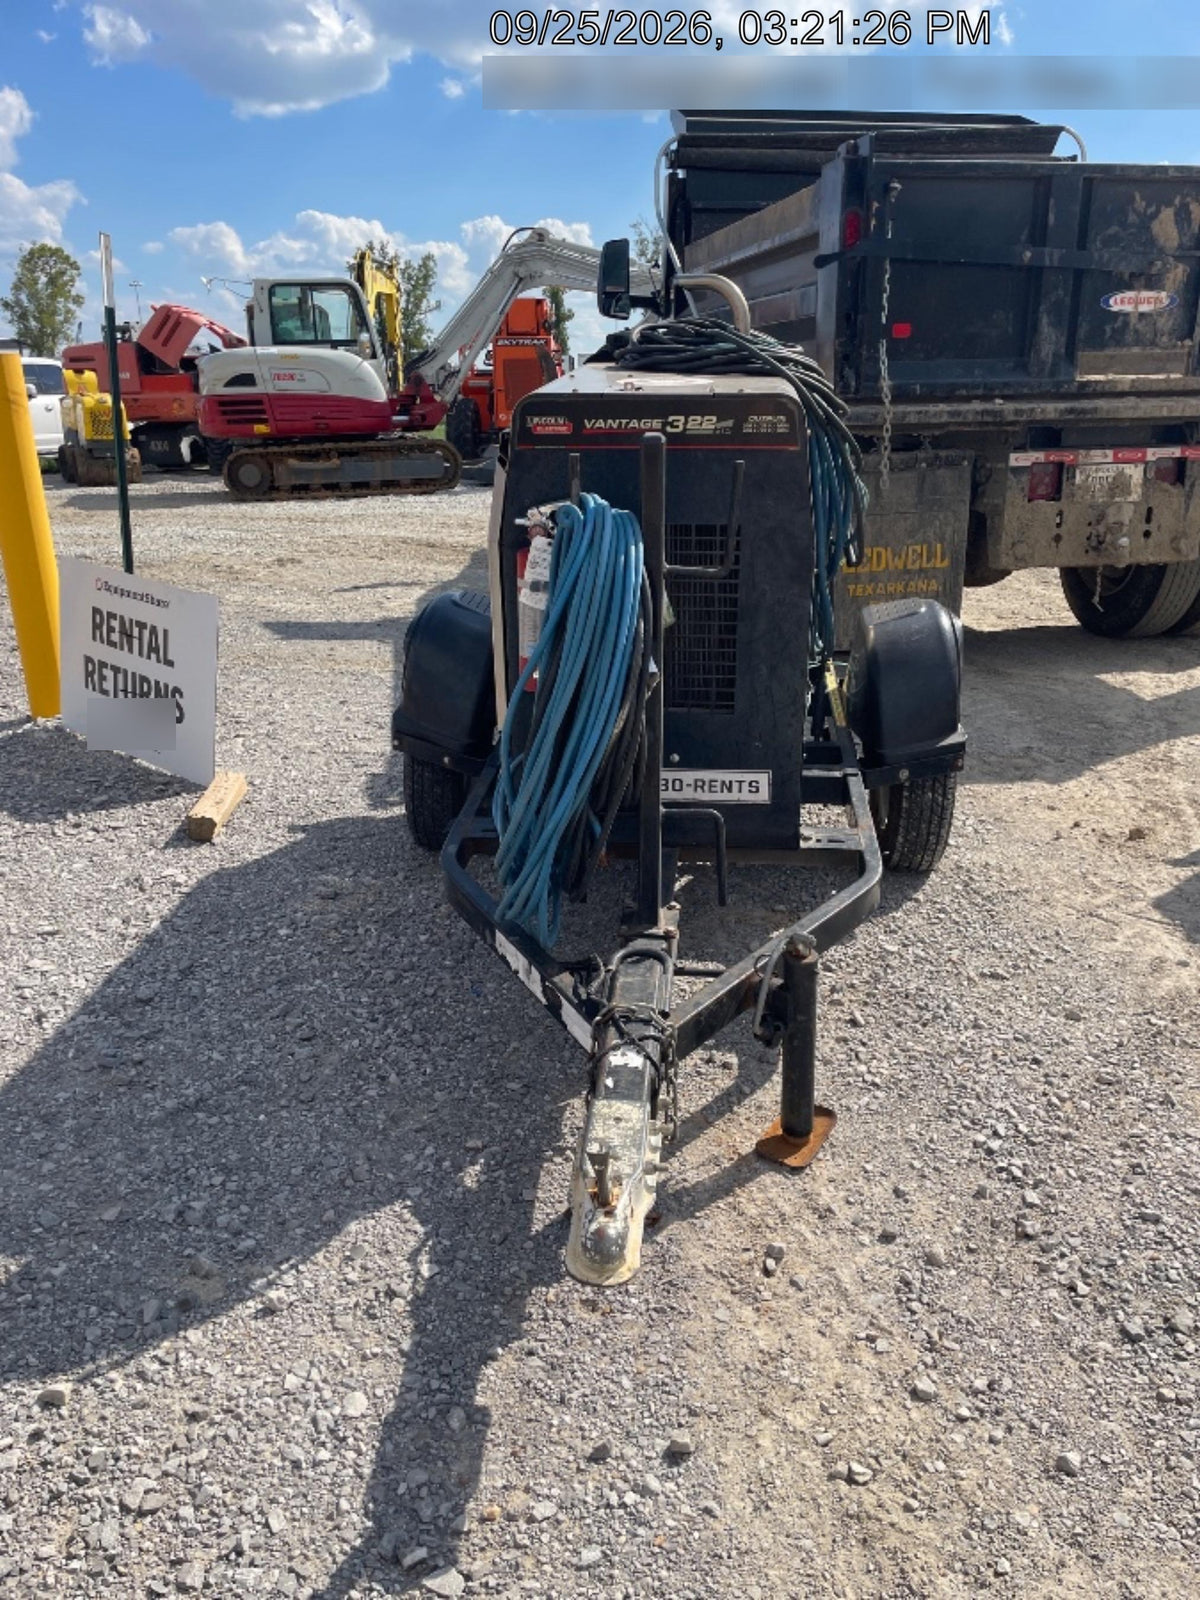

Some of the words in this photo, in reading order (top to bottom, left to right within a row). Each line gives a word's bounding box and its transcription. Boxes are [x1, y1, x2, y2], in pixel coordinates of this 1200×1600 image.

[497, 338, 547, 346] SKYTRAK
[583, 418, 664, 430] VANTAGE
[666, 415, 718, 433] 322
[91, 605, 175, 669] RENTAL
